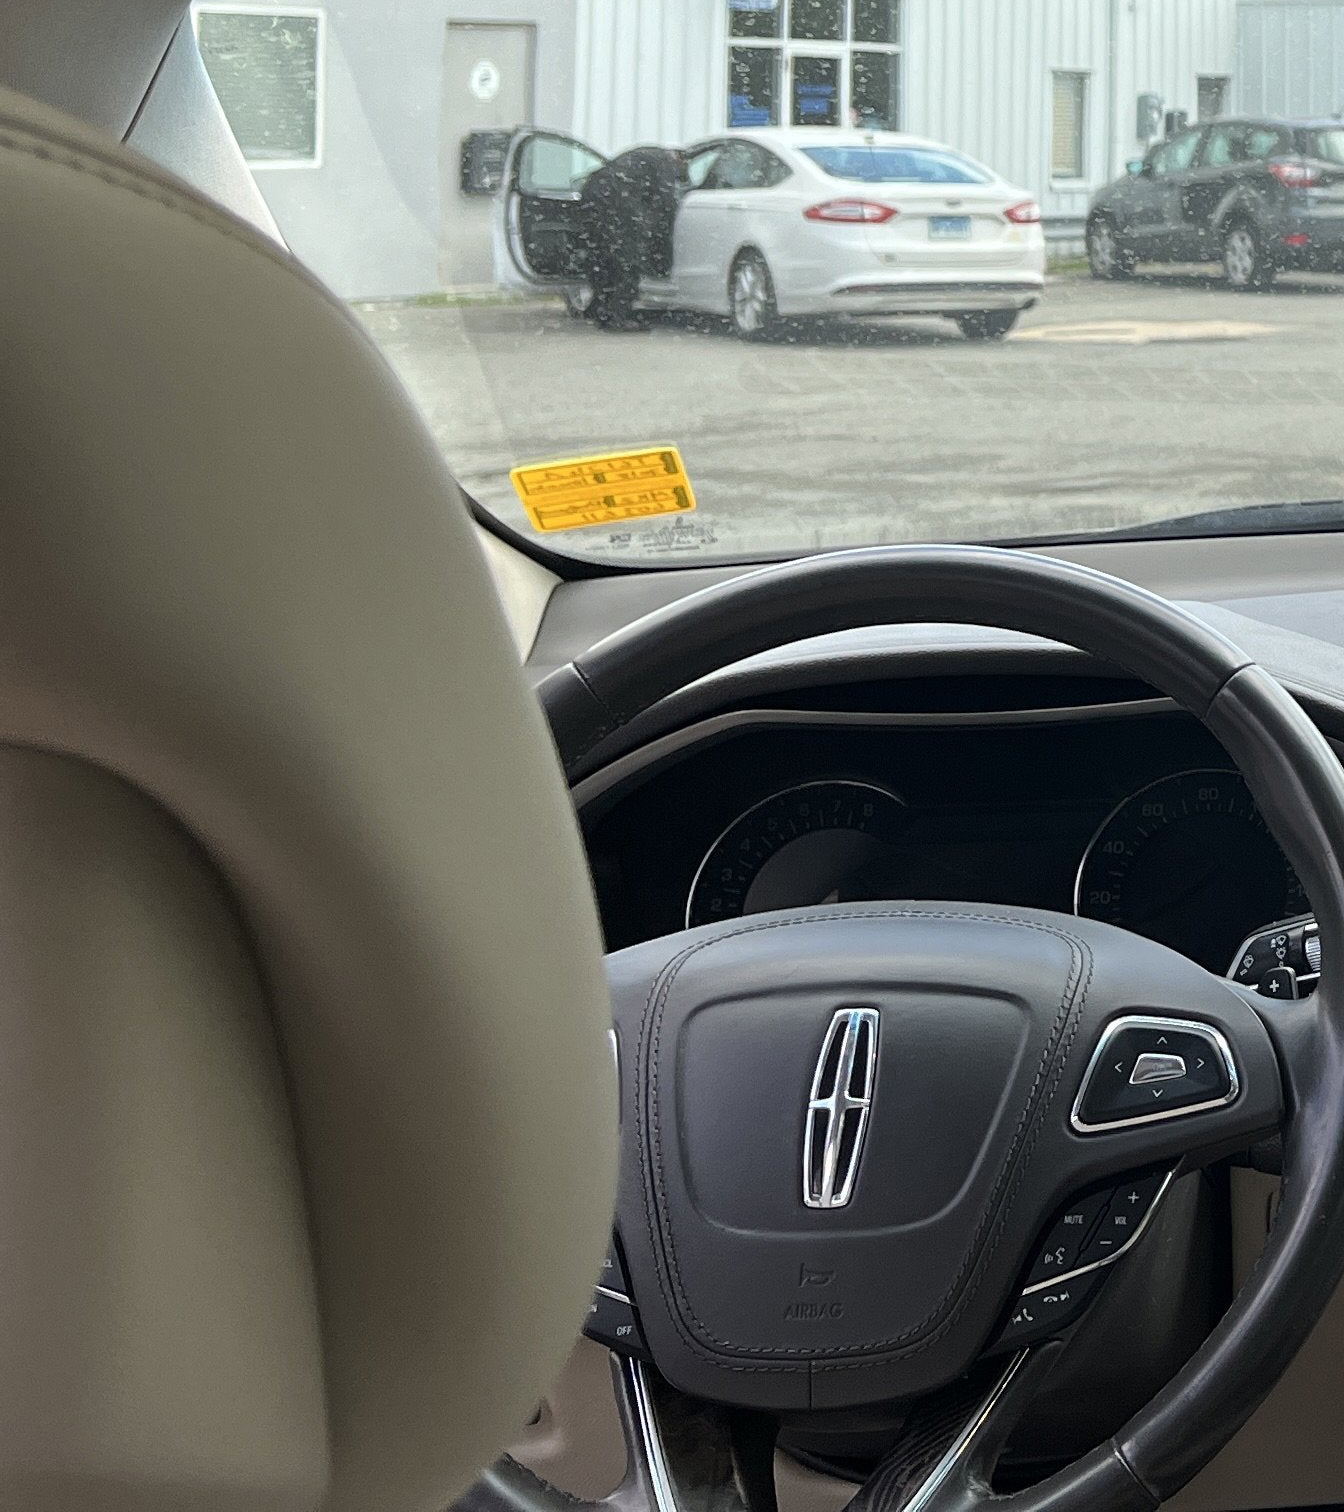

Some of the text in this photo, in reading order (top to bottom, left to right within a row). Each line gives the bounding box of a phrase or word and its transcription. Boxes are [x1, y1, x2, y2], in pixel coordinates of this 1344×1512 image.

[1141, 803, 1165, 818] 60
[1102, 840, 1125, 855] 40
[1088, 890, 1112, 905] 20
[1063, 1214, 1085, 1225] MUTE
[1114, 1215, 1128, 1226] VOL
[784, 1302, 844, 1321] AIRBAG
[616, 1325, 632, 1337] OFF
